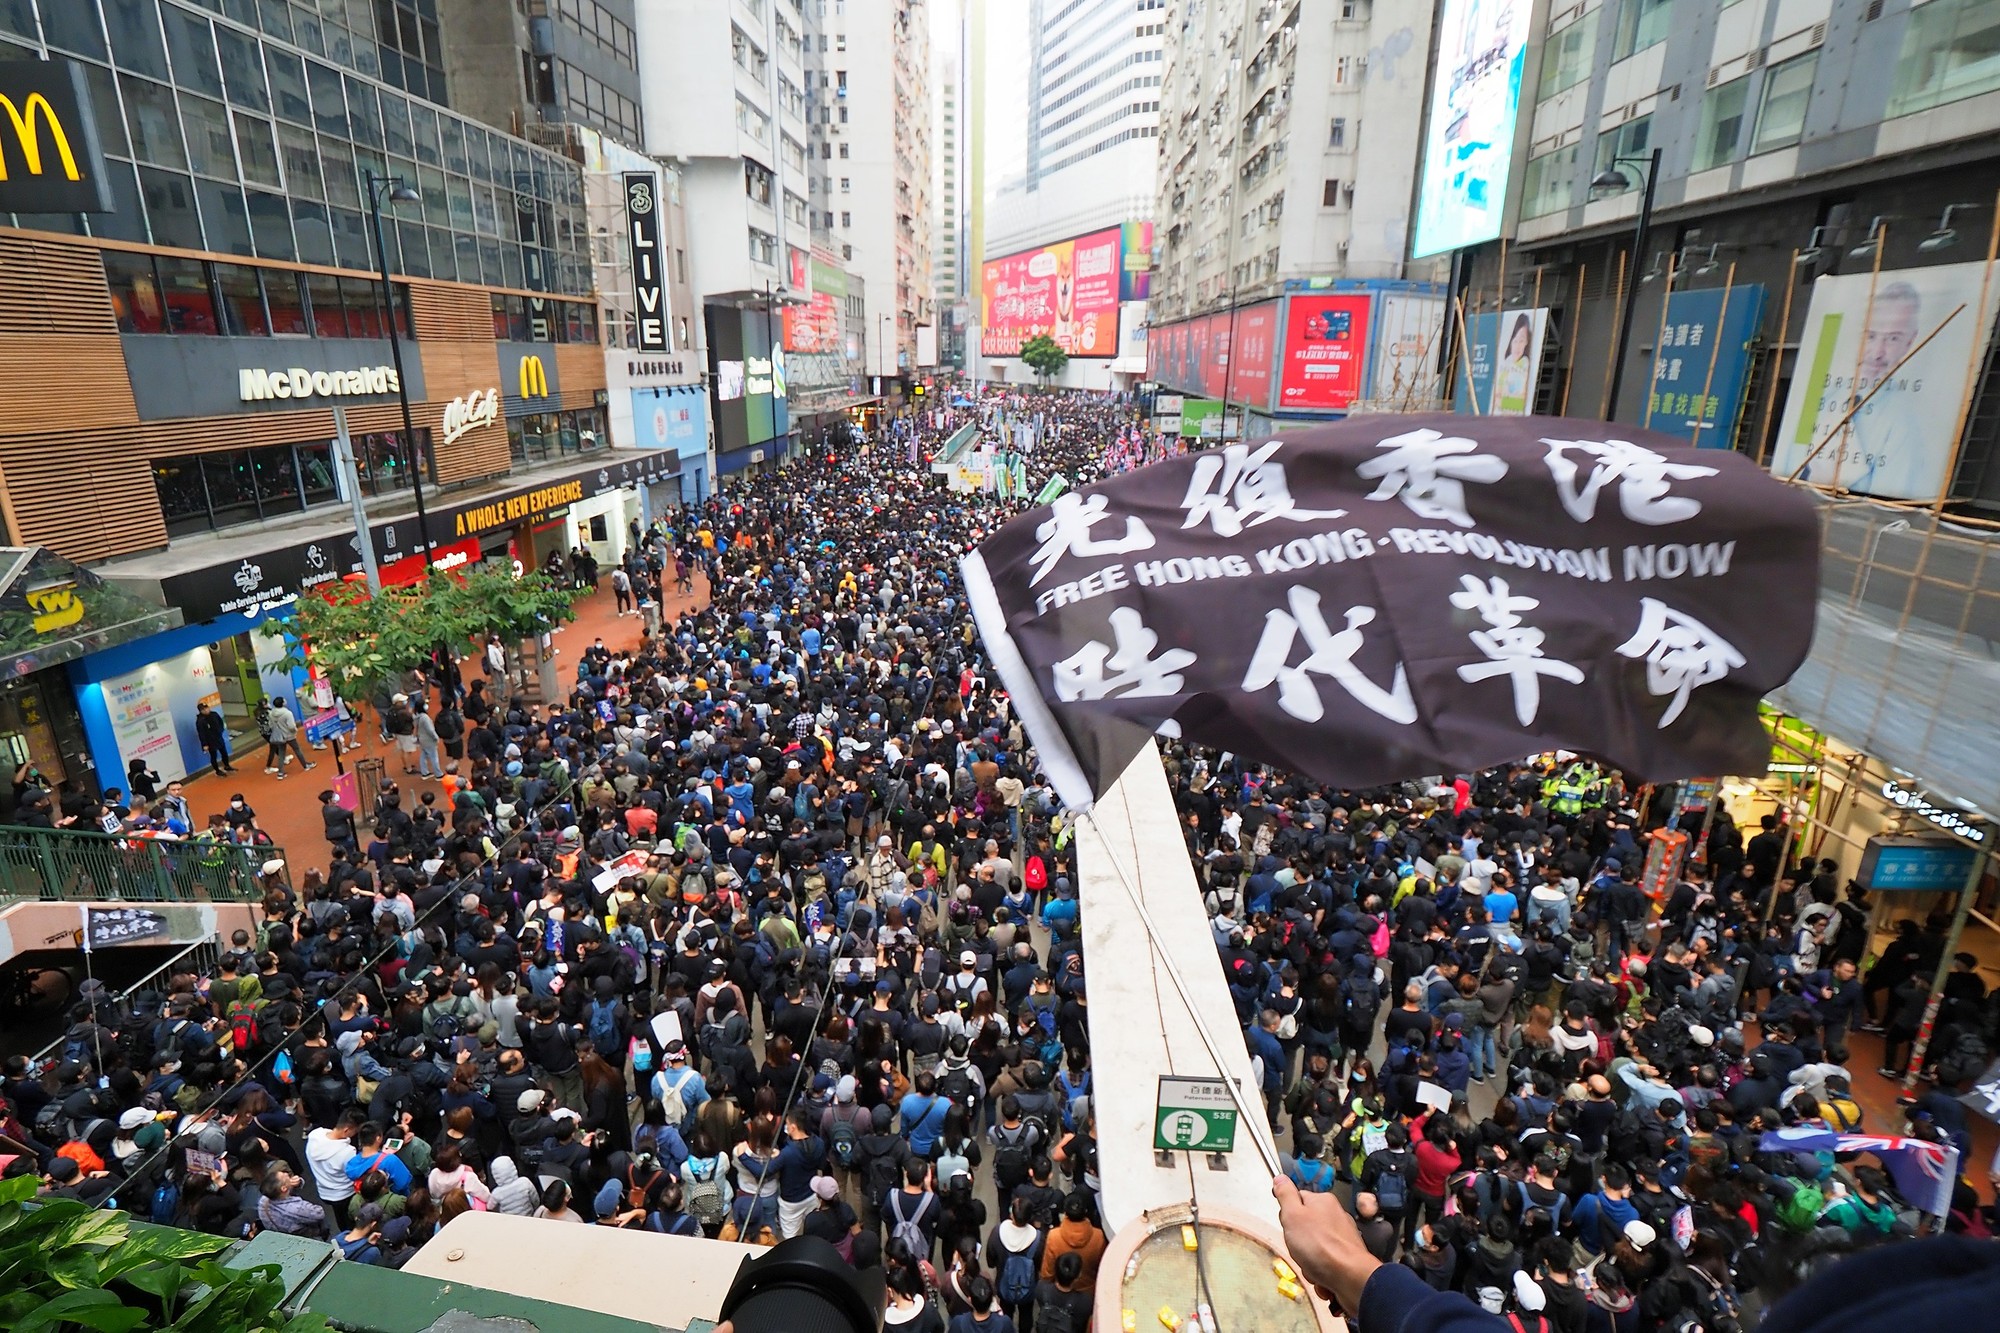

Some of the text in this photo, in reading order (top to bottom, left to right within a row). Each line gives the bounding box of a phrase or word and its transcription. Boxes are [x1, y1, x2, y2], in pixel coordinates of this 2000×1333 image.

[629, 182, 653, 215] 3
[634, 220, 663, 345] LIVE
[239, 366, 400, 401] McDonald's
[1818, 396, 1875, 416] BOOS
[1812, 422, 1856, 438] WIH
[456, 480, 583, 537] A WHOLE NEW EXPERIENCE
[1036, 564, 1130, 616] FREE
[1133, 555, 1252, 588] HONG
[1622, 540, 1737, 582] NOW
[1213, 1112, 1232, 1120] 53E
